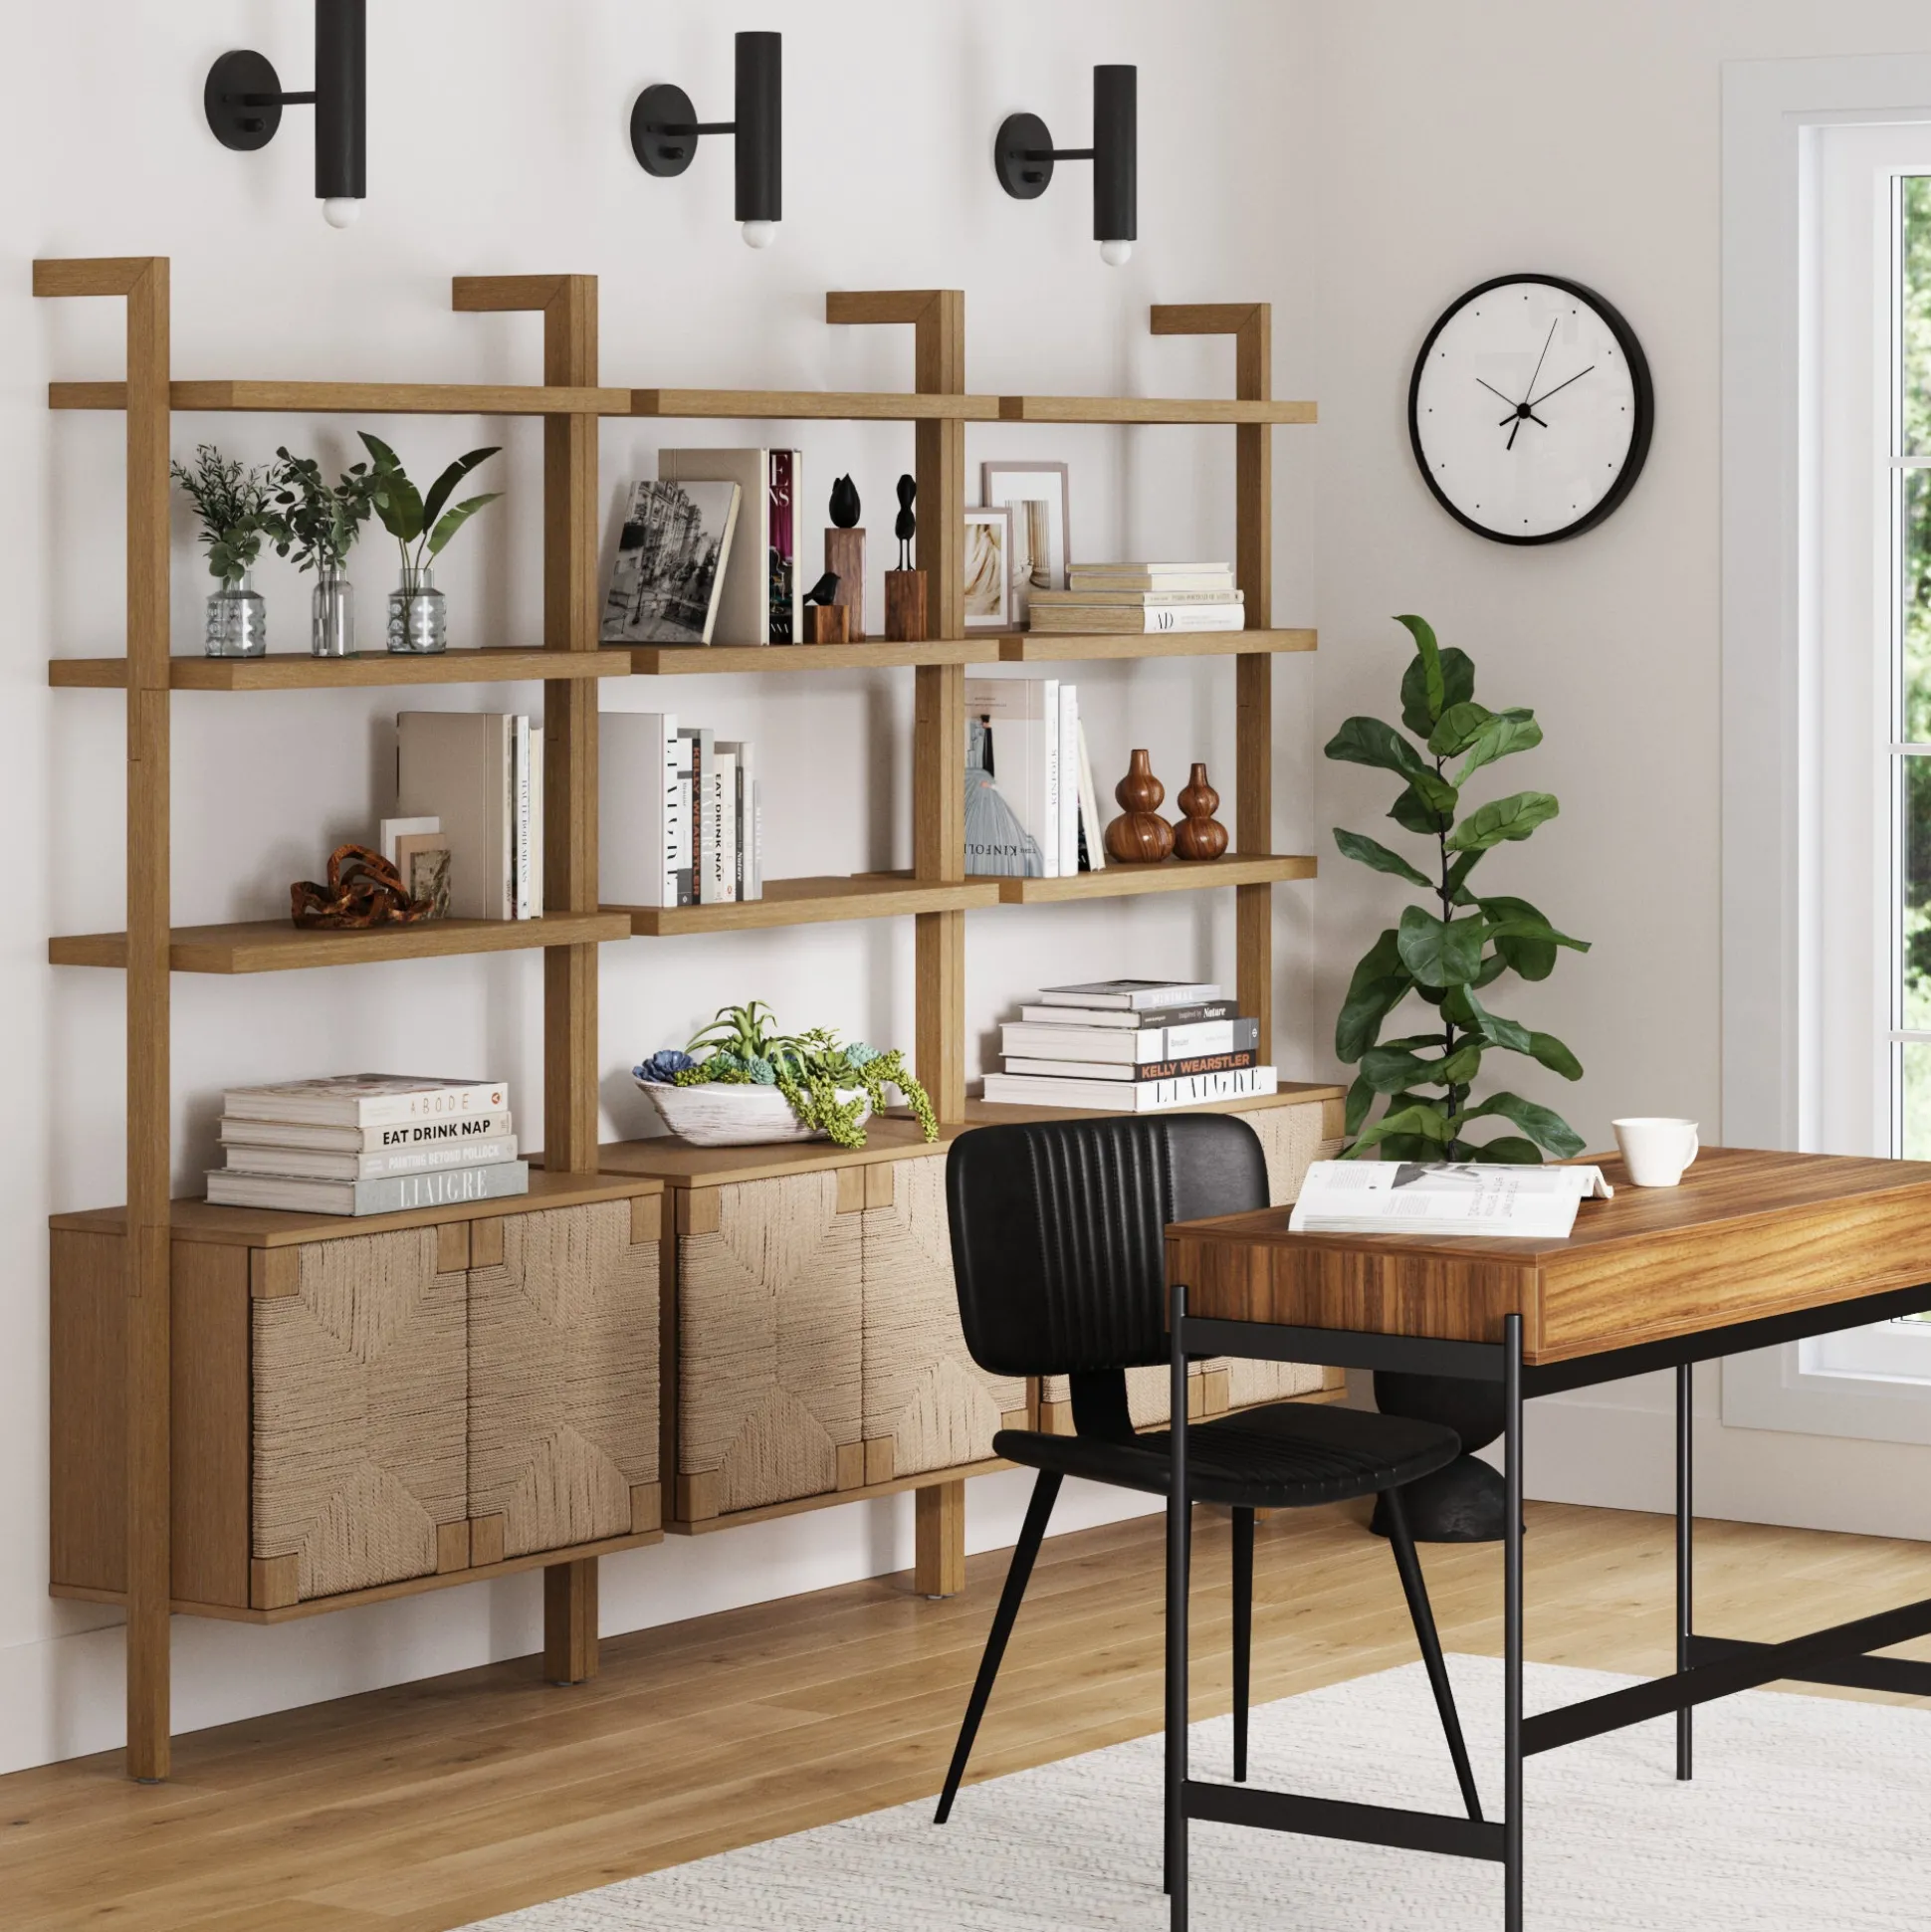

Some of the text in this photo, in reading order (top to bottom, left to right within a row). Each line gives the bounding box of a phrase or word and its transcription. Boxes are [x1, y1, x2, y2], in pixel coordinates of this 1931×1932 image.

[1155, 611, 1175, 630] AD
[1153, 990, 1193, 1004] MINIMAL
[1203, 1007, 1226, 1018] Nature
[1142, 1053, 1250, 1078] KELLY WEARSTLER
[410, 1093, 471, 1116] ABODE
[383, 1130, 409, 1145] EAT
[413, 1124, 458, 1142] DRINK
[462, 1120, 491, 1137] NAP
[388, 1154, 427, 1171] PAINTING
[428, 1149, 460, 1167] BEYOND
[463, 1144, 500, 1163] POLLOCK
[400, 1169, 488, 1207] LIAIGRE
